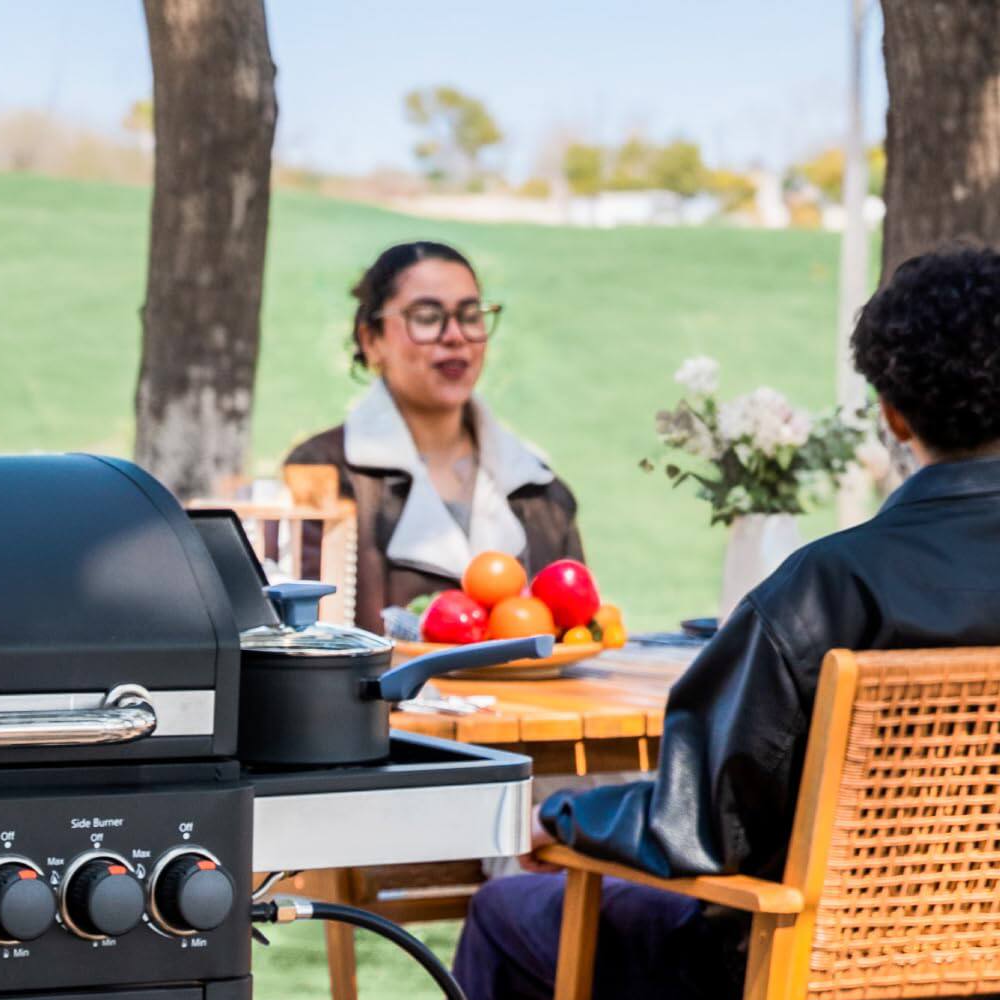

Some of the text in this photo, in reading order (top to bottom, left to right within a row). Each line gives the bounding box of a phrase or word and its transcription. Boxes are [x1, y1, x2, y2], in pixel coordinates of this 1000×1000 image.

[70, 817, 124, 829] Side Burner
[178, 822, 194, 833] Off
[0, 831, 15, 842] Off
[89, 832, 104, 843] Off
[132, 848, 151, 859] Max
[47, 857, 65, 867] Max
[191, 937, 208, 948] Min
[13, 947, 30, 958] Min
